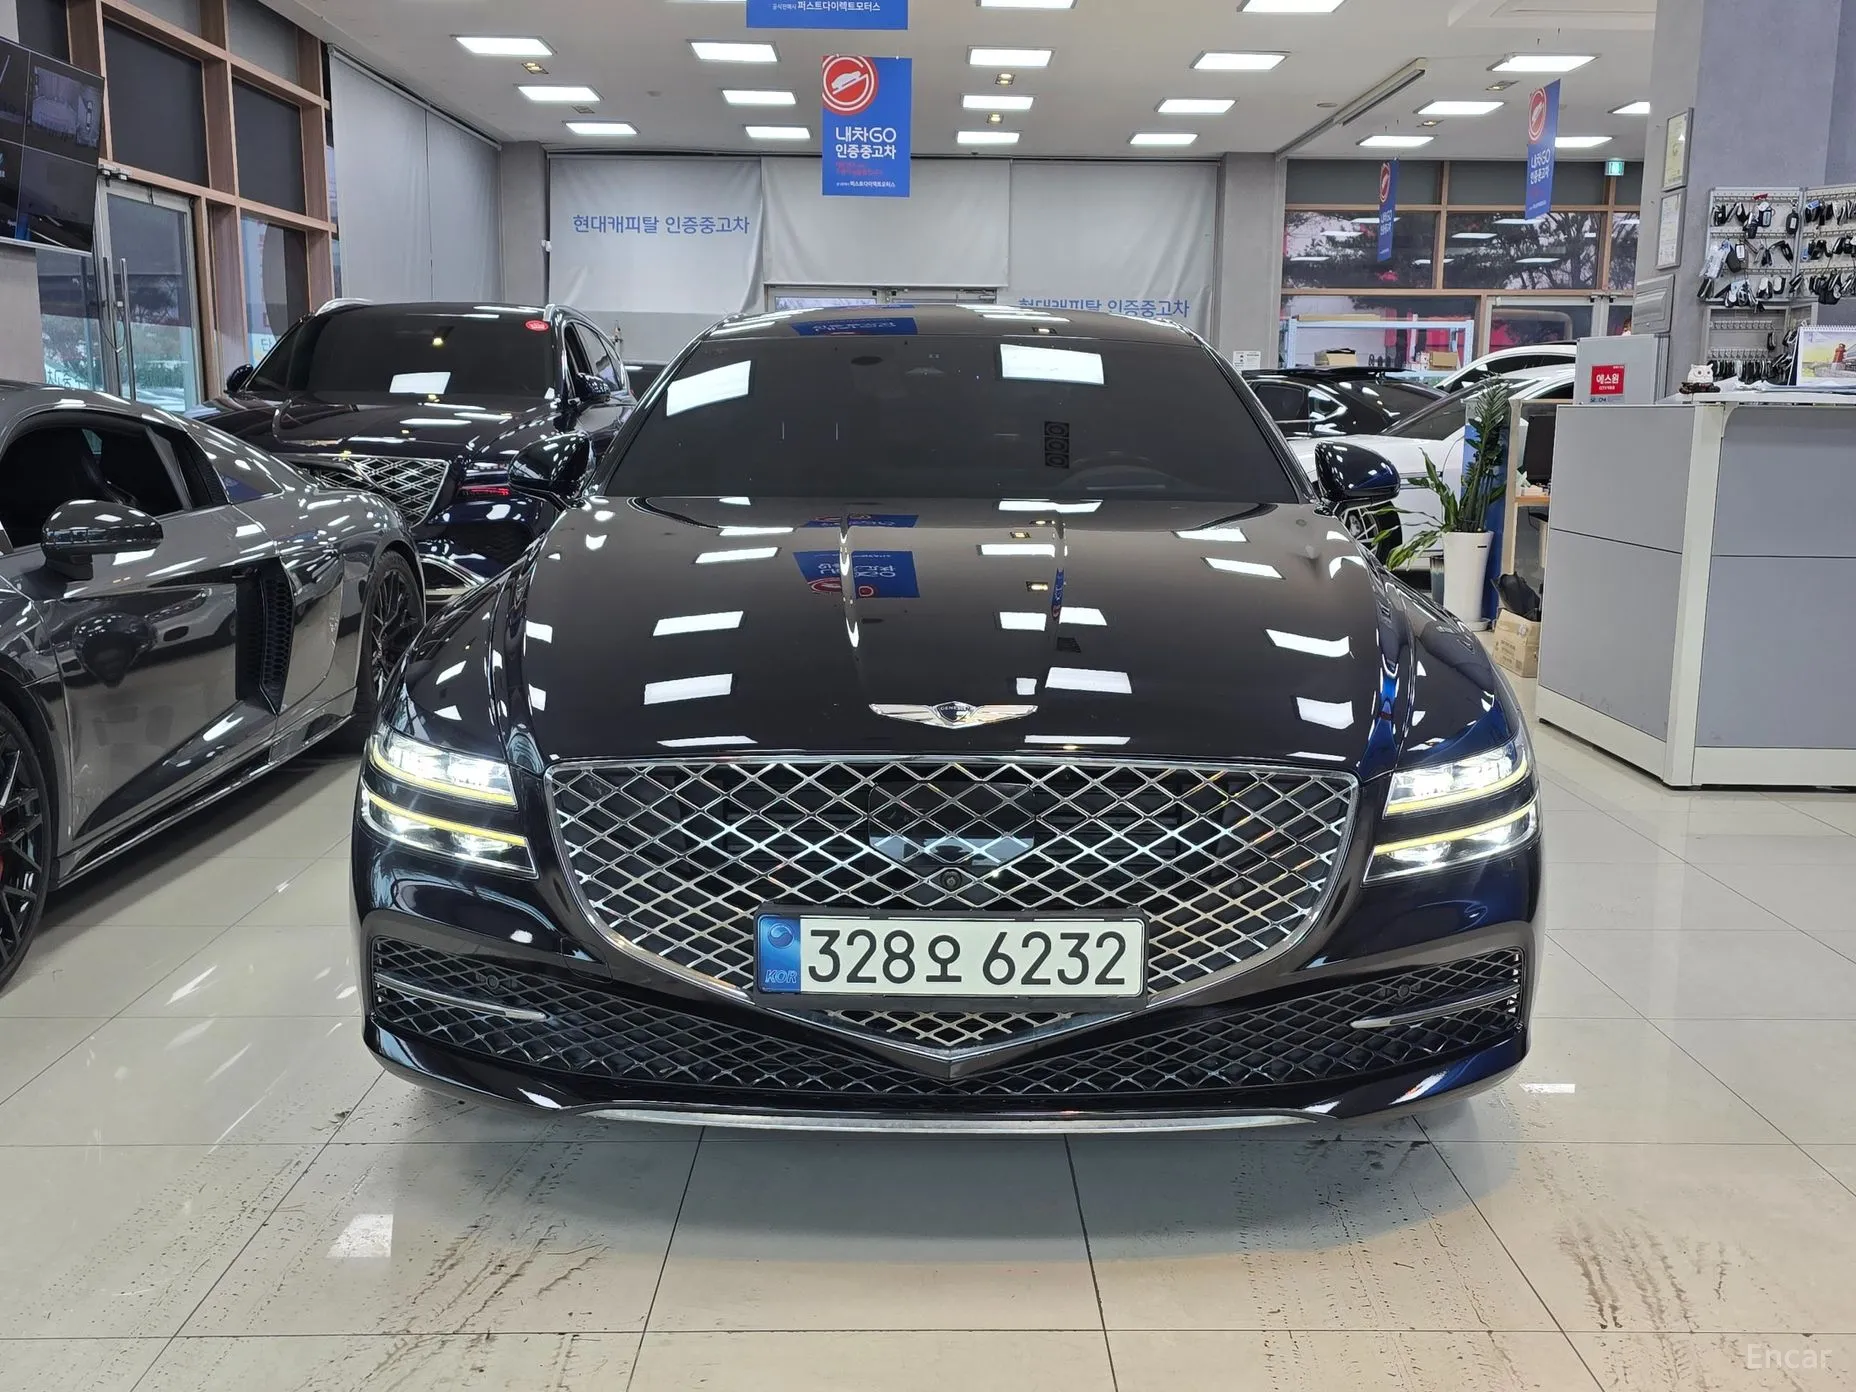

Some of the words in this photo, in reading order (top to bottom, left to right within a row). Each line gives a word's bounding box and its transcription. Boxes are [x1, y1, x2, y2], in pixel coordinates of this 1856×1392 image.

[797, 0, 881, 12] 퍼스트다이렉트모터스
[835, 126, 897, 143] 내차GO
[835, 143, 897, 160] 인증중고차
[572, 214, 660, 234] 현대캐피탈
[665, 215, 751, 234] 인증중고차
[1595, 373, 1619, 384] 에스원
[808, 928, 963, 984] 328오
[982, 930, 1126, 986] 6232
[765, 969, 798, 984] KOR
